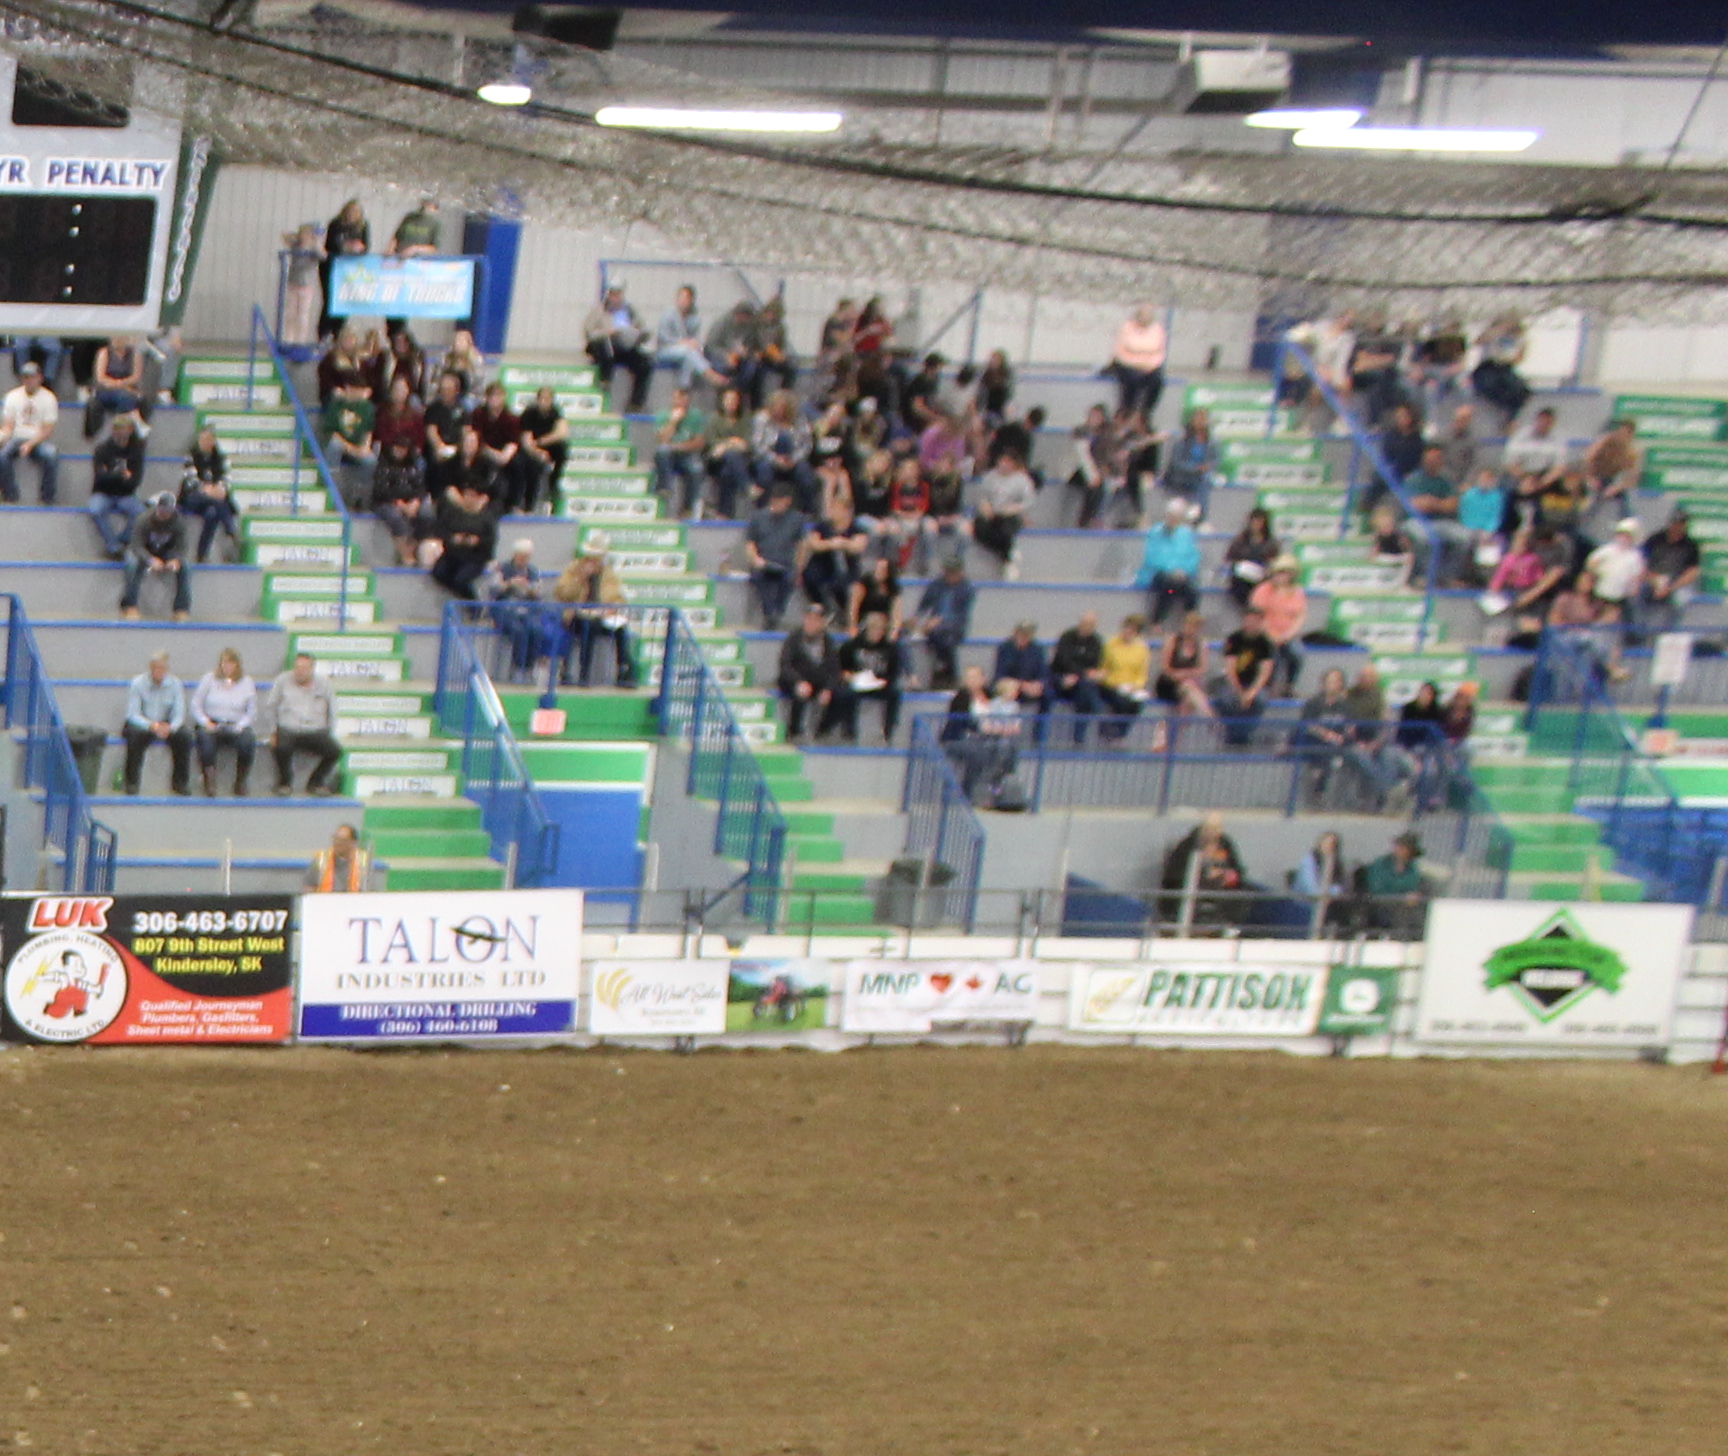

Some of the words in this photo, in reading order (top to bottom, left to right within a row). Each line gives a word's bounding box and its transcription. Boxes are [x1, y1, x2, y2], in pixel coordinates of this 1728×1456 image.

[47, 159, 168, 188] PENALTY
[31, 899, 110, 929] LUK
[133, 910, 288, 933] 306-463-6707
[133, 937, 166, 953] 807
[168, 937, 194, 953] 9th
[197, 937, 244, 952] Street
[246, 936, 285, 951] West
[348, 915, 541, 965] TALON
[155, 956, 238, 976] Kindersley,
[240, 956, 263, 971] SK
[335, 971, 486, 990] INDUSTRIES
[500, 969, 546, 987] LTD
[859, 972, 921, 994] MNP
[995, 972, 1033, 994] AG
[1144, 970, 1314, 1009] PATTISON
[342, 1003, 456, 1019] DIRECTIONAL
[460, 1001, 538, 1018] DRILLING
